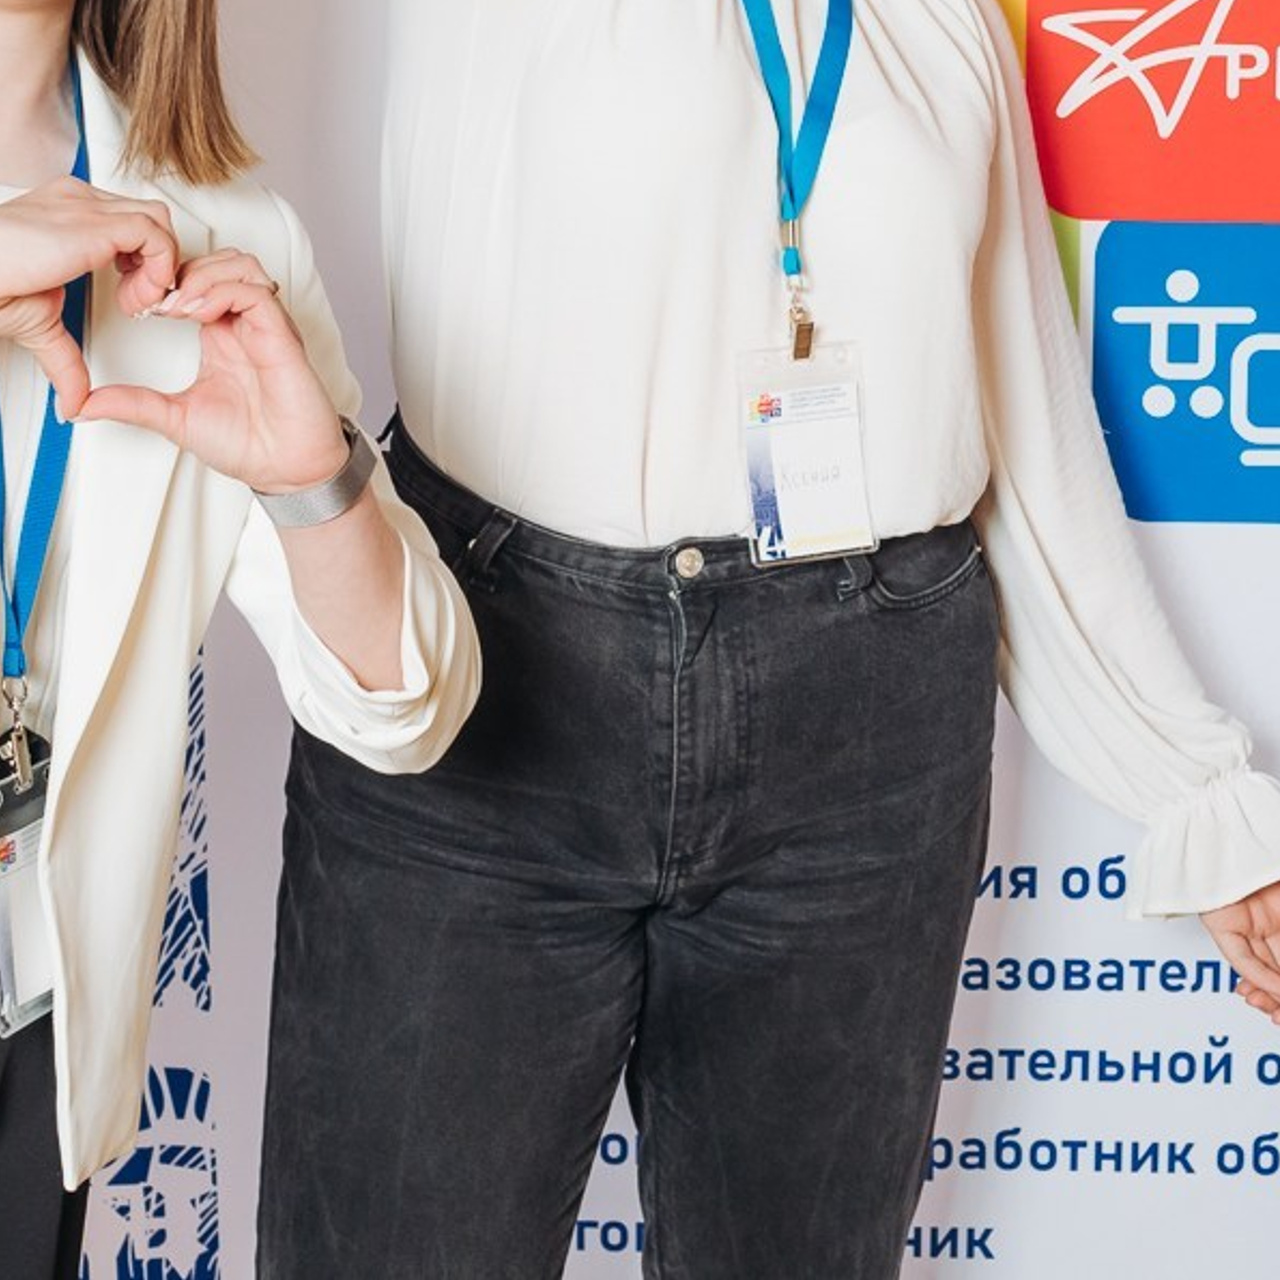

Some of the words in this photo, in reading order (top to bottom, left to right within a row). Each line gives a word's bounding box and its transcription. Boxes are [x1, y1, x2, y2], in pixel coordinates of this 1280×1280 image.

[975, 865, 1037, 899] ия
[1062, 854, 1127, 900] об
[961, 956, 1242, 993] азовател
[942, 1035, 1233, 1084] вательной
[906, 1226, 995, 1259] ник
